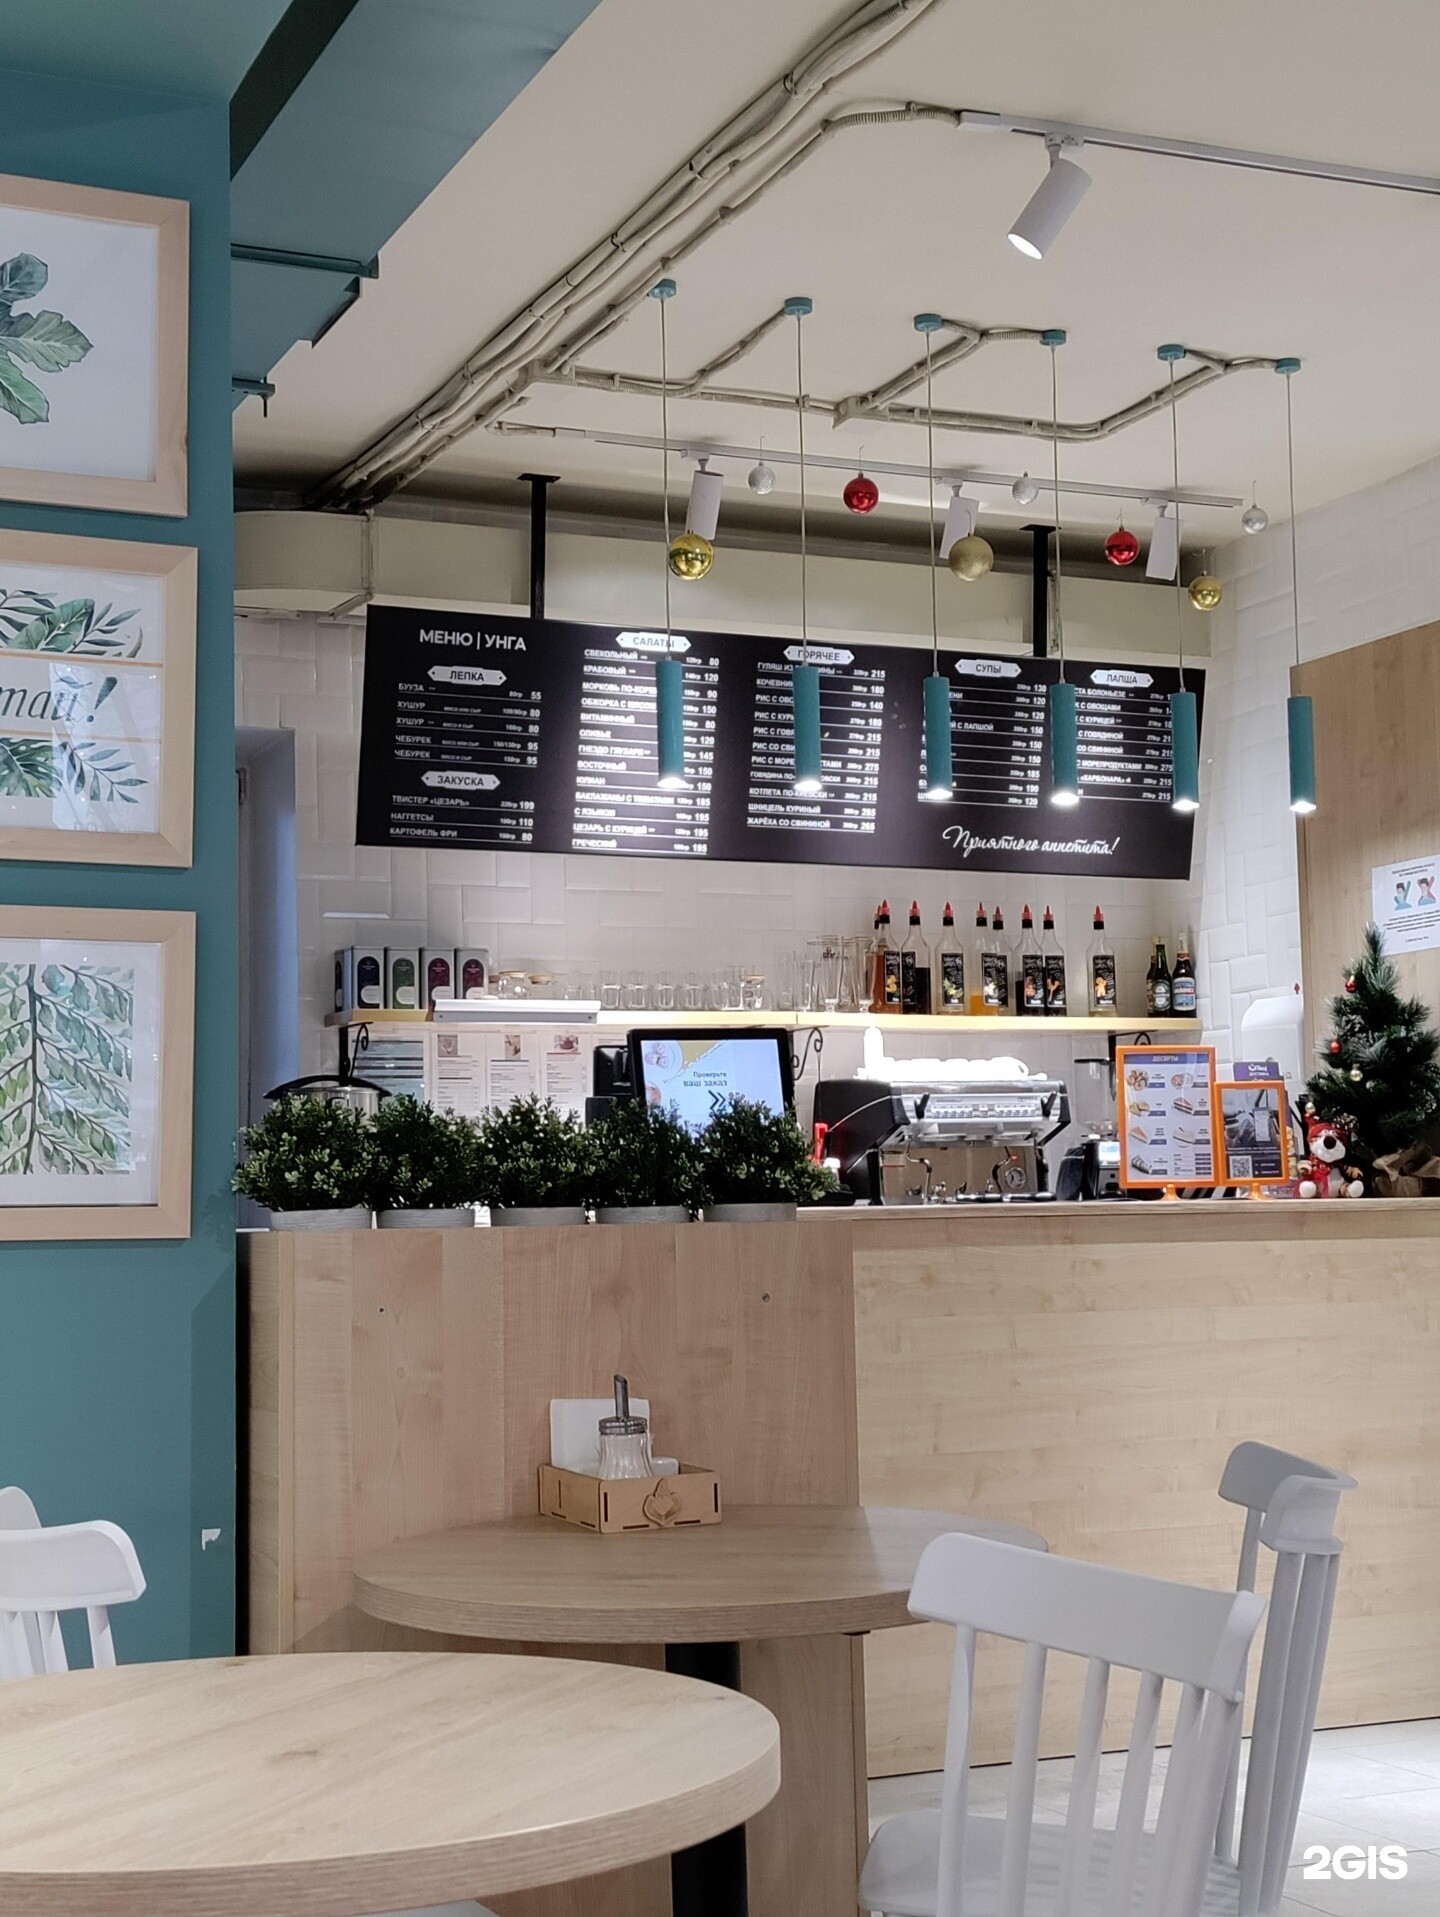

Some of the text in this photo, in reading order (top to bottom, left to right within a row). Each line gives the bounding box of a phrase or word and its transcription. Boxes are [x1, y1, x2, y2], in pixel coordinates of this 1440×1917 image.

[420, 629, 473, 646] МЕНЮ
[484, 634, 527, 651] УНГА
[633, 637, 675, 648] САЛАТЫ
[797, 650, 840, 660] ГОРЯЧЕЕ
[709, 657, 719, 666] 80
[757, 662, 782, 670] ГУЛЯШ
[871, 670, 886, 678] 215
[975, 664, 1001, 673] СУПЫ
[450, 670, 485, 682] ЛЕПКА
[704, 673, 718, 682] 120
[1107, 674, 1137, 684] ЛАПША
[398, 683, 424, 691] БУУЗА
[531, 691, 542, 700] 55
[582, 682, 620, 691] МОРКОВЬ
[707, 690, 718, 698] 90
[871, 685, 884, 694] 180
[1034, 684, 1047, 692] 130
[1087, 688, 1126, 698] БОЛОНЬЕЗЕ
[755, 694, 770, 702] РИС
[869, 701, 884, 710] 140
[1033, 696, 1046, 705] 120
[397, 701, 426, 709] ХУШУР
[530, 708, 540, 717] 80
[702, 705, 717, 714] 150
[1086, 702, 1121, 711] ОВОЩАМИ
[754, 711, 769, 719] РИС
[868, 718, 883, 726] 180
[1032, 711, 1045, 720] 120
[1085, 716, 1115, 724] КУРИЦЕЙ
[396, 717, 425, 725] ХУШУР
[528, 724, 539, 733] 80
[705, 720, 716, 729] 80
[963, 722, 994, 731] ЛАПШОЙ
[1030, 726, 1044, 735] 150
[753, 726, 768, 734] РИС
[867, 733, 882, 741] 215
[1084, 730, 1124, 739] ГОВЯДИНОЙ
[395, 734, 431, 744] ЧЕБУРЕК
[527, 742, 538, 750] 95
[700, 736, 715, 745] 120
[1029, 741, 1042, 749] 150
[752, 742, 767, 750] РИС
[865, 748, 880, 757] 215
[1088, 745, 1123, 754] СВИНИНОЙ
[394, 750, 430, 758] ЧЕБУРЕК
[526, 756, 538, 765] 95
[699, 751, 714, 760] 145
[1028, 755, 1041, 764] 150
[751, 756, 766, 764] РИС
[864, 762, 880, 771] 275
[698, 767, 713, 775] 150
[1026, 770, 1040, 778] 185
[437, 775, 484, 786] ЗАКУСКА
[750, 771, 783, 779] ГОВЯДИНА
[864, 776, 878, 785] 215
[1159, 778, 1172, 786] 215
[697, 782, 712, 791] 150
[1026, 784, 1039, 793] 190
[749, 787, 781, 796] КОТЛЕТА
[862, 792, 877, 801] 215
[1158, 792, 1171, 800] 215
[392, 794, 428, 804] ТВИСТЕР
[519, 801, 535, 810] 199
[1025, 797, 1038, 806] 120
[748, 803, 785, 812] ШНИЦЕЛЬ
[786, 805, 821, 814] КУРИНЫЙ
[391, 812, 434, 821] НАГГЕТСЫ
[519, 818, 533, 826] 110
[790, 819, 830, 828] СВИНИНОЙ
[573, 823, 604, 832] ЦЕЗАРЬ
[604, 824, 611, 832] С
[390, 827, 438, 837] КАРТОФЕЛЬ
[522, 832, 533, 841] 80
[942, 825, 1121, 857] Приятного аппетита!
